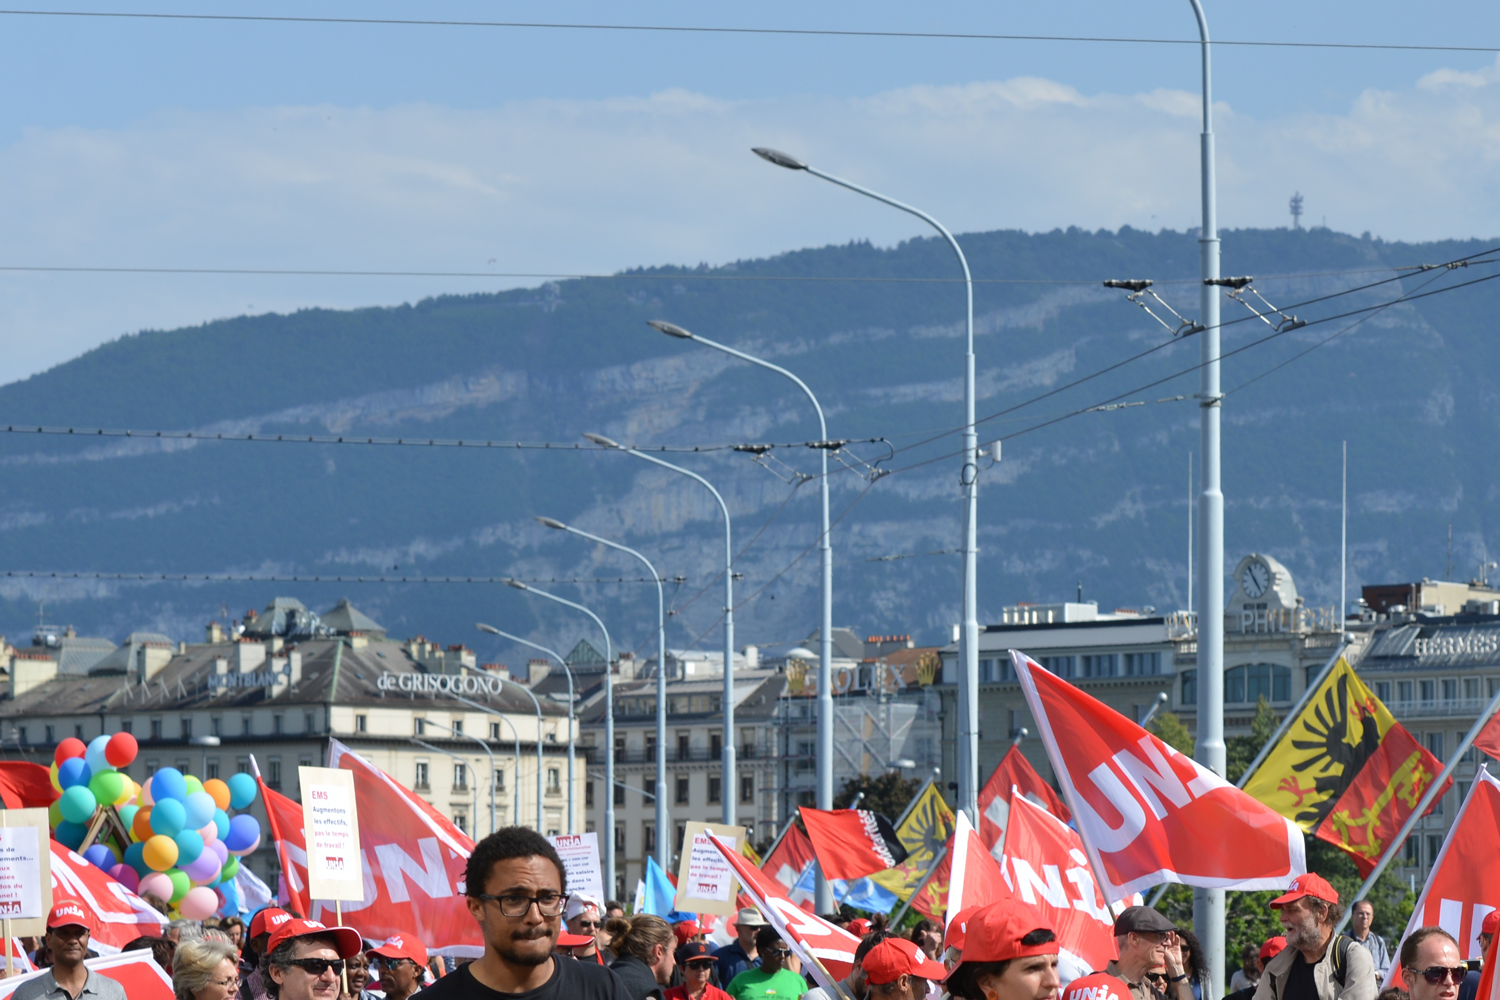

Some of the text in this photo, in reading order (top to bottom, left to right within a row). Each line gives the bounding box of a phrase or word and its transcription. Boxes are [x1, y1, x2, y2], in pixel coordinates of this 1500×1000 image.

[208, 671, 284, 688] MONTBLANC
[377, 670, 503, 695] de GRISOGONO
[815, 662, 907, 693] OLX
[312, 791, 329, 801] EMS
[312, 806, 346, 815] Augmentons
